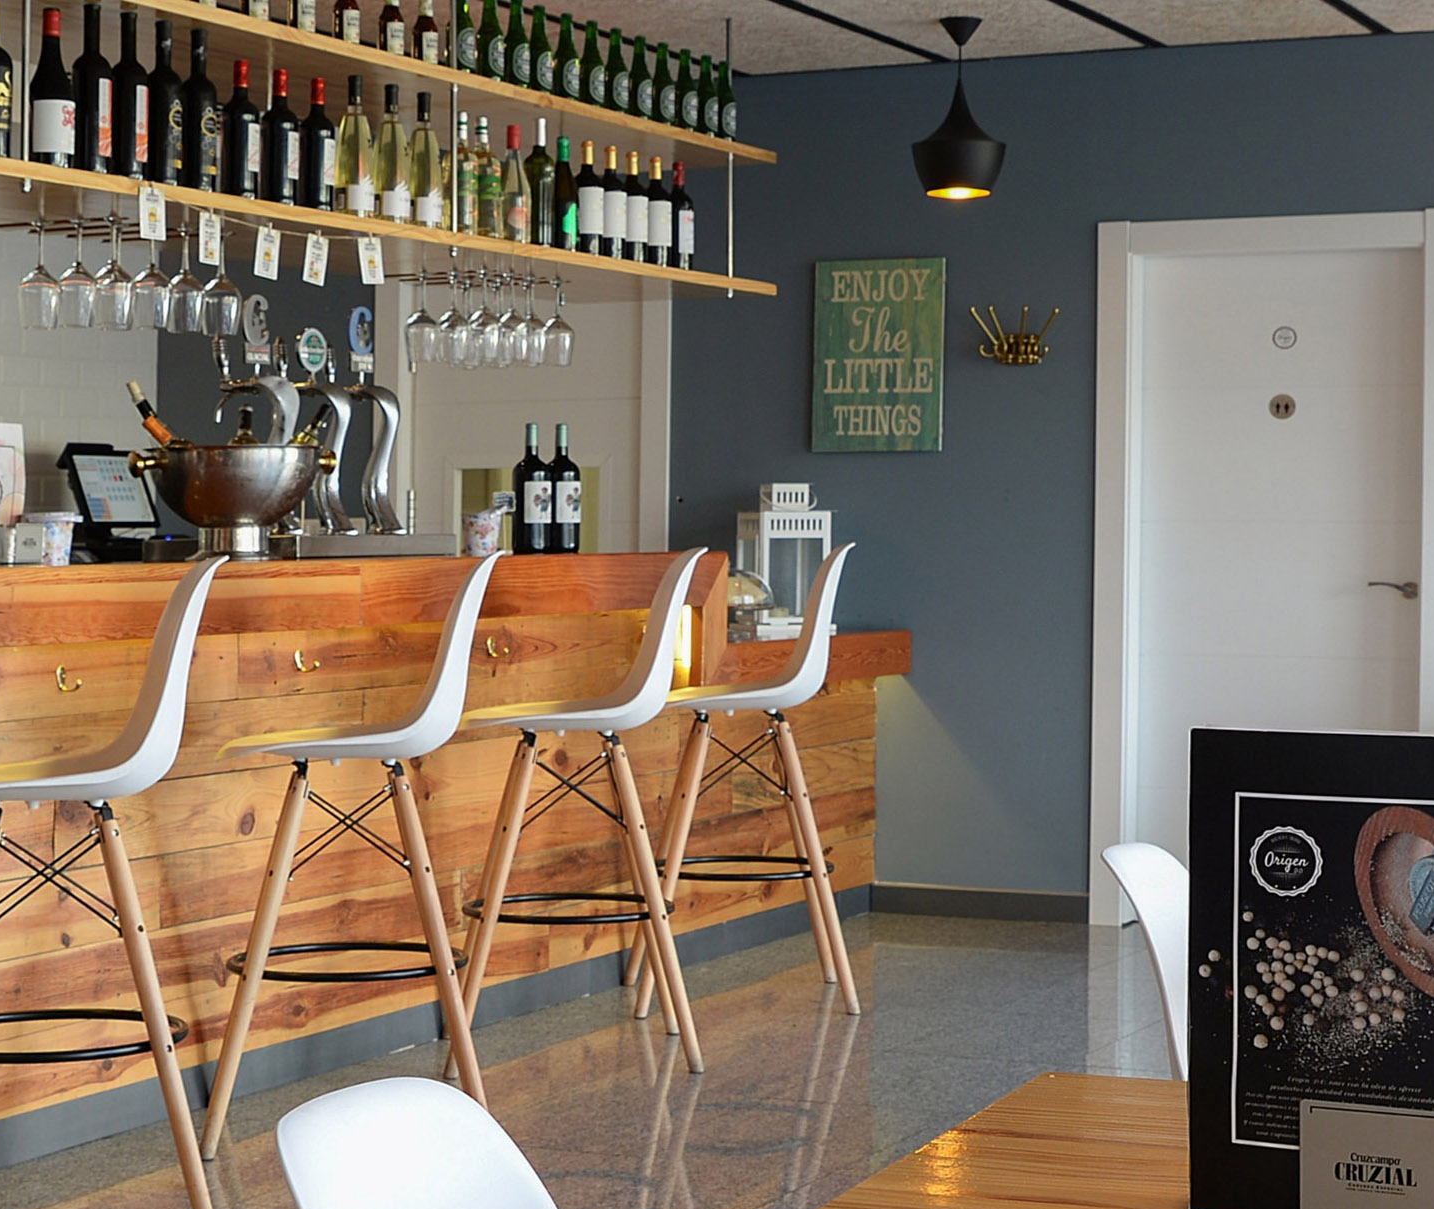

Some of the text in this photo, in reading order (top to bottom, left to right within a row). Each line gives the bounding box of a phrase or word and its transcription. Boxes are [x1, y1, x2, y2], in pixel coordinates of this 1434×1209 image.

[831, 268, 931, 303] ENJOY
[848, 305, 911, 353] The
[823, 357, 934, 394] LITTLE
[833, 404, 922, 436] THINGS
[1264, 851, 1310, 873] Origen
[1334, 1161, 1418, 1188] CRUZIAL
[1350, 1152, 1401, 1166] Cruzcampo
